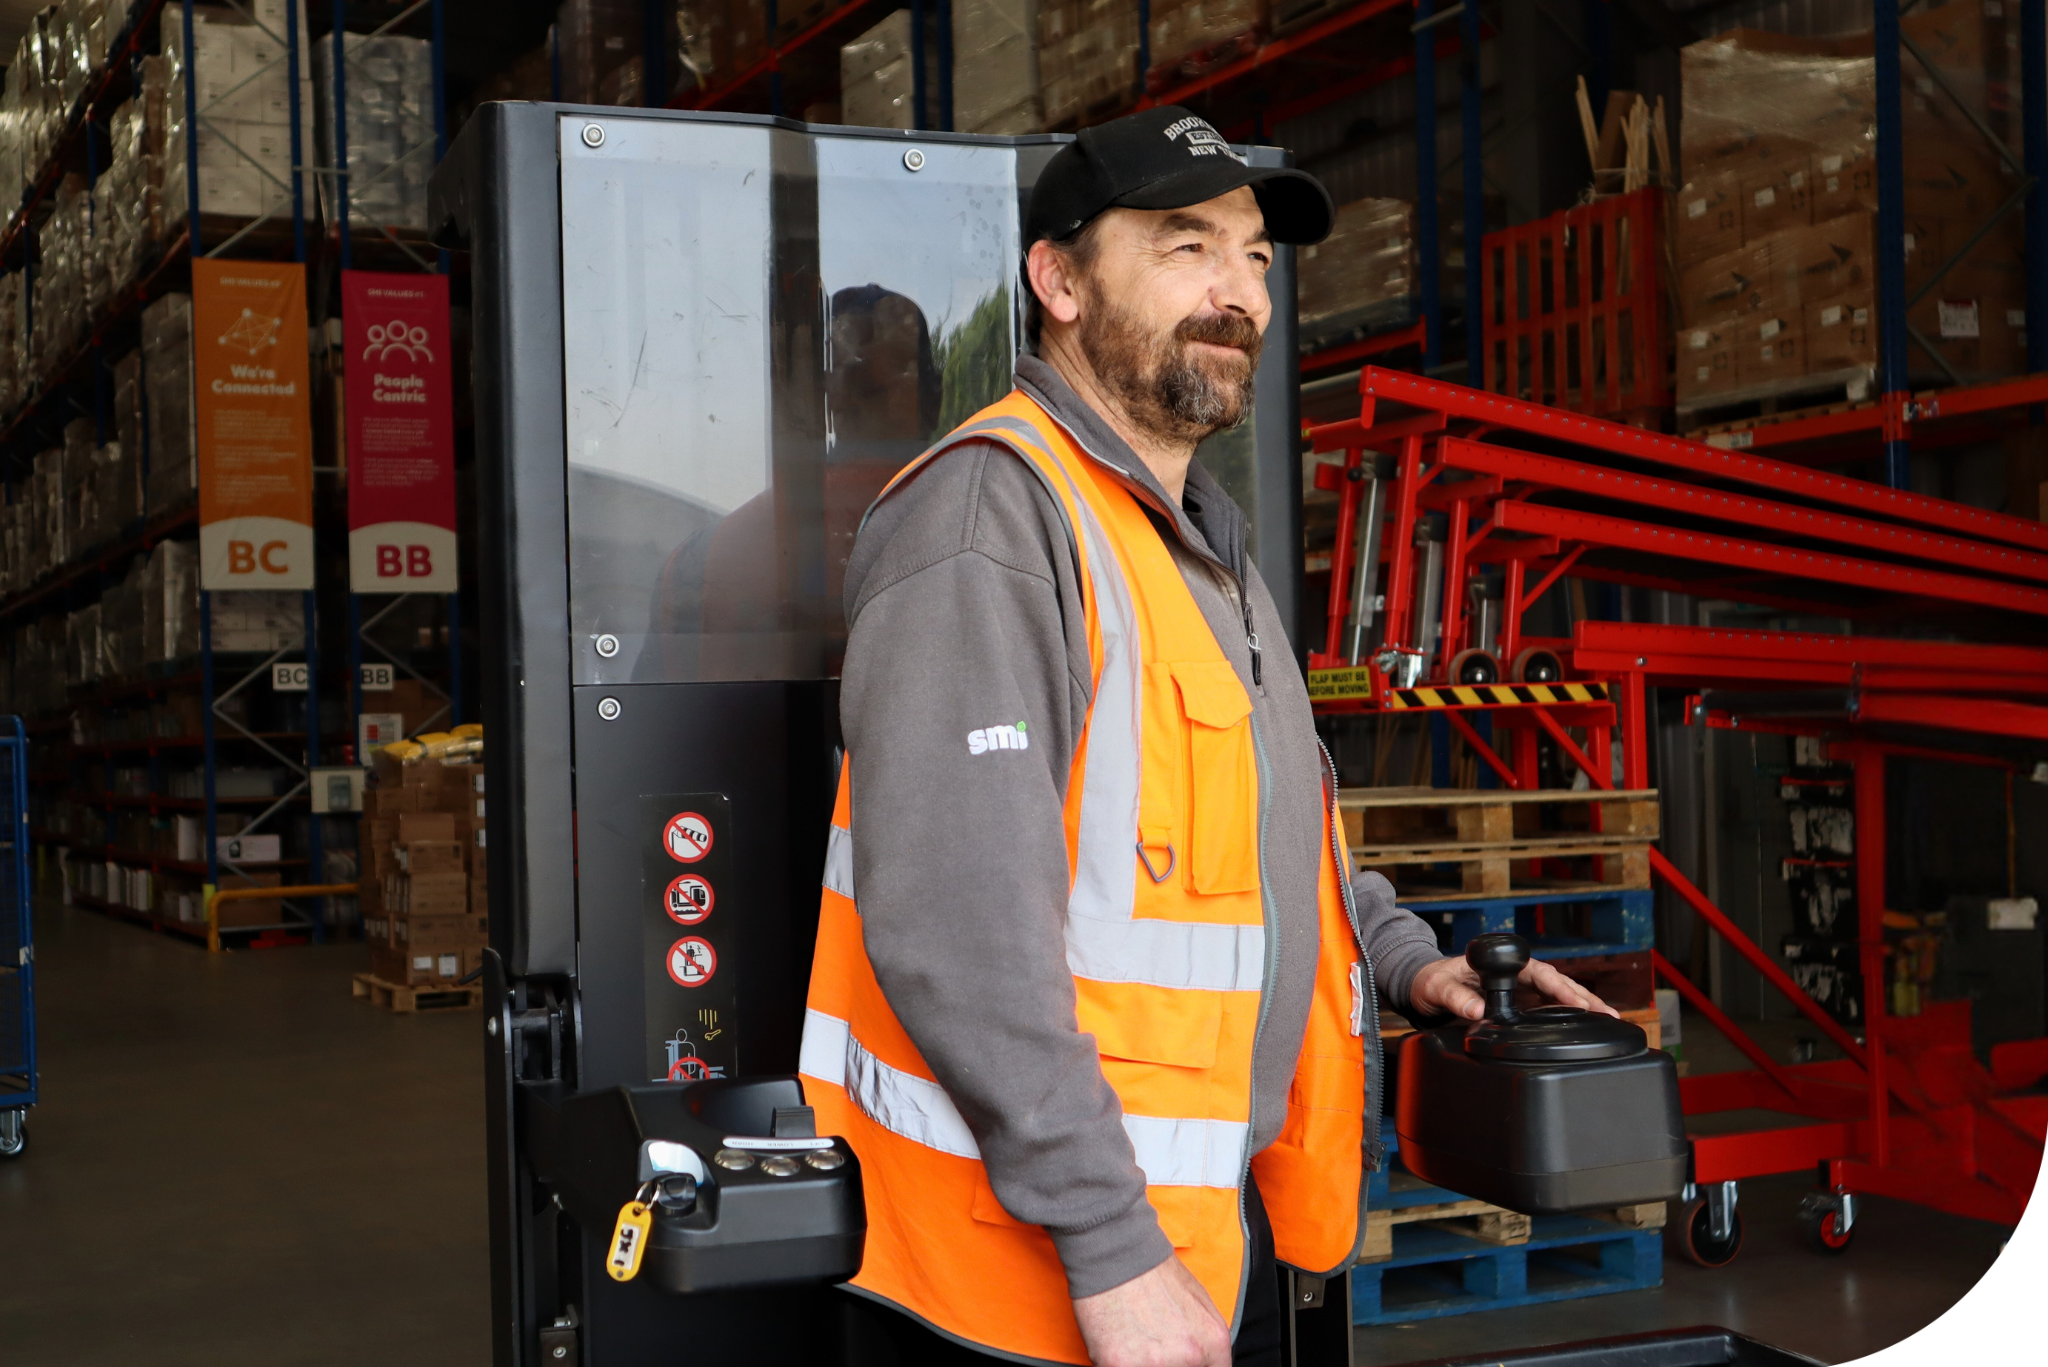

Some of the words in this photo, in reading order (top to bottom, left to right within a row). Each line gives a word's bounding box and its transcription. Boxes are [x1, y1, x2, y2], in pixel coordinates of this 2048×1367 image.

[1187, 145, 1218, 157] NEW
[237, 278, 269, 289] VALUES
[368, 288, 382, 297] SMI
[383, 289, 414, 298] VALUES
[230, 364, 277, 380] We're
[211, 379, 296, 396] Connected
[374, 373, 424, 389] People
[372, 387, 426, 403] Centric
[227, 540, 289, 575] BC
[376, 544, 433, 578] BB
[277, 668, 307, 685] BC
[361, 668, 390, 685] BB
[1310, 673, 1329, 684] FLAP
[1332, 672, 1353, 683] MUST
[1356, 671, 1366, 681] BE
[1338, 683, 1369, 694] MOVING
[967, 720, 1029, 755] smi
